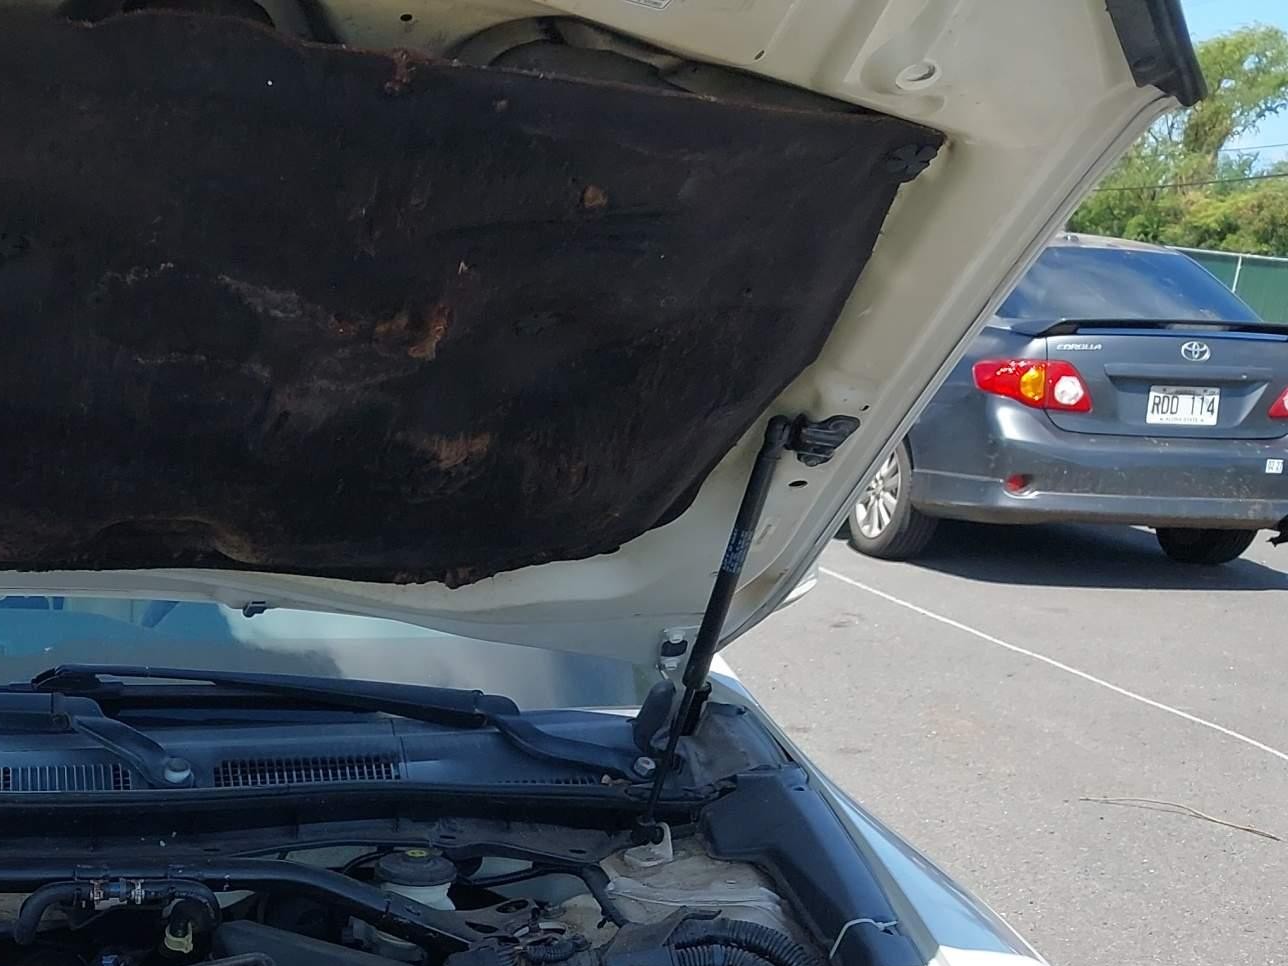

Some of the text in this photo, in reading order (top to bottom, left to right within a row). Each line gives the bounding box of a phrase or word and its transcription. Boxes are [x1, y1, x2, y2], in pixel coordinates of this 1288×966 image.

[1056, 343, 1103, 351] COROLLA
[1151, 395, 1216, 416] RDD 114
